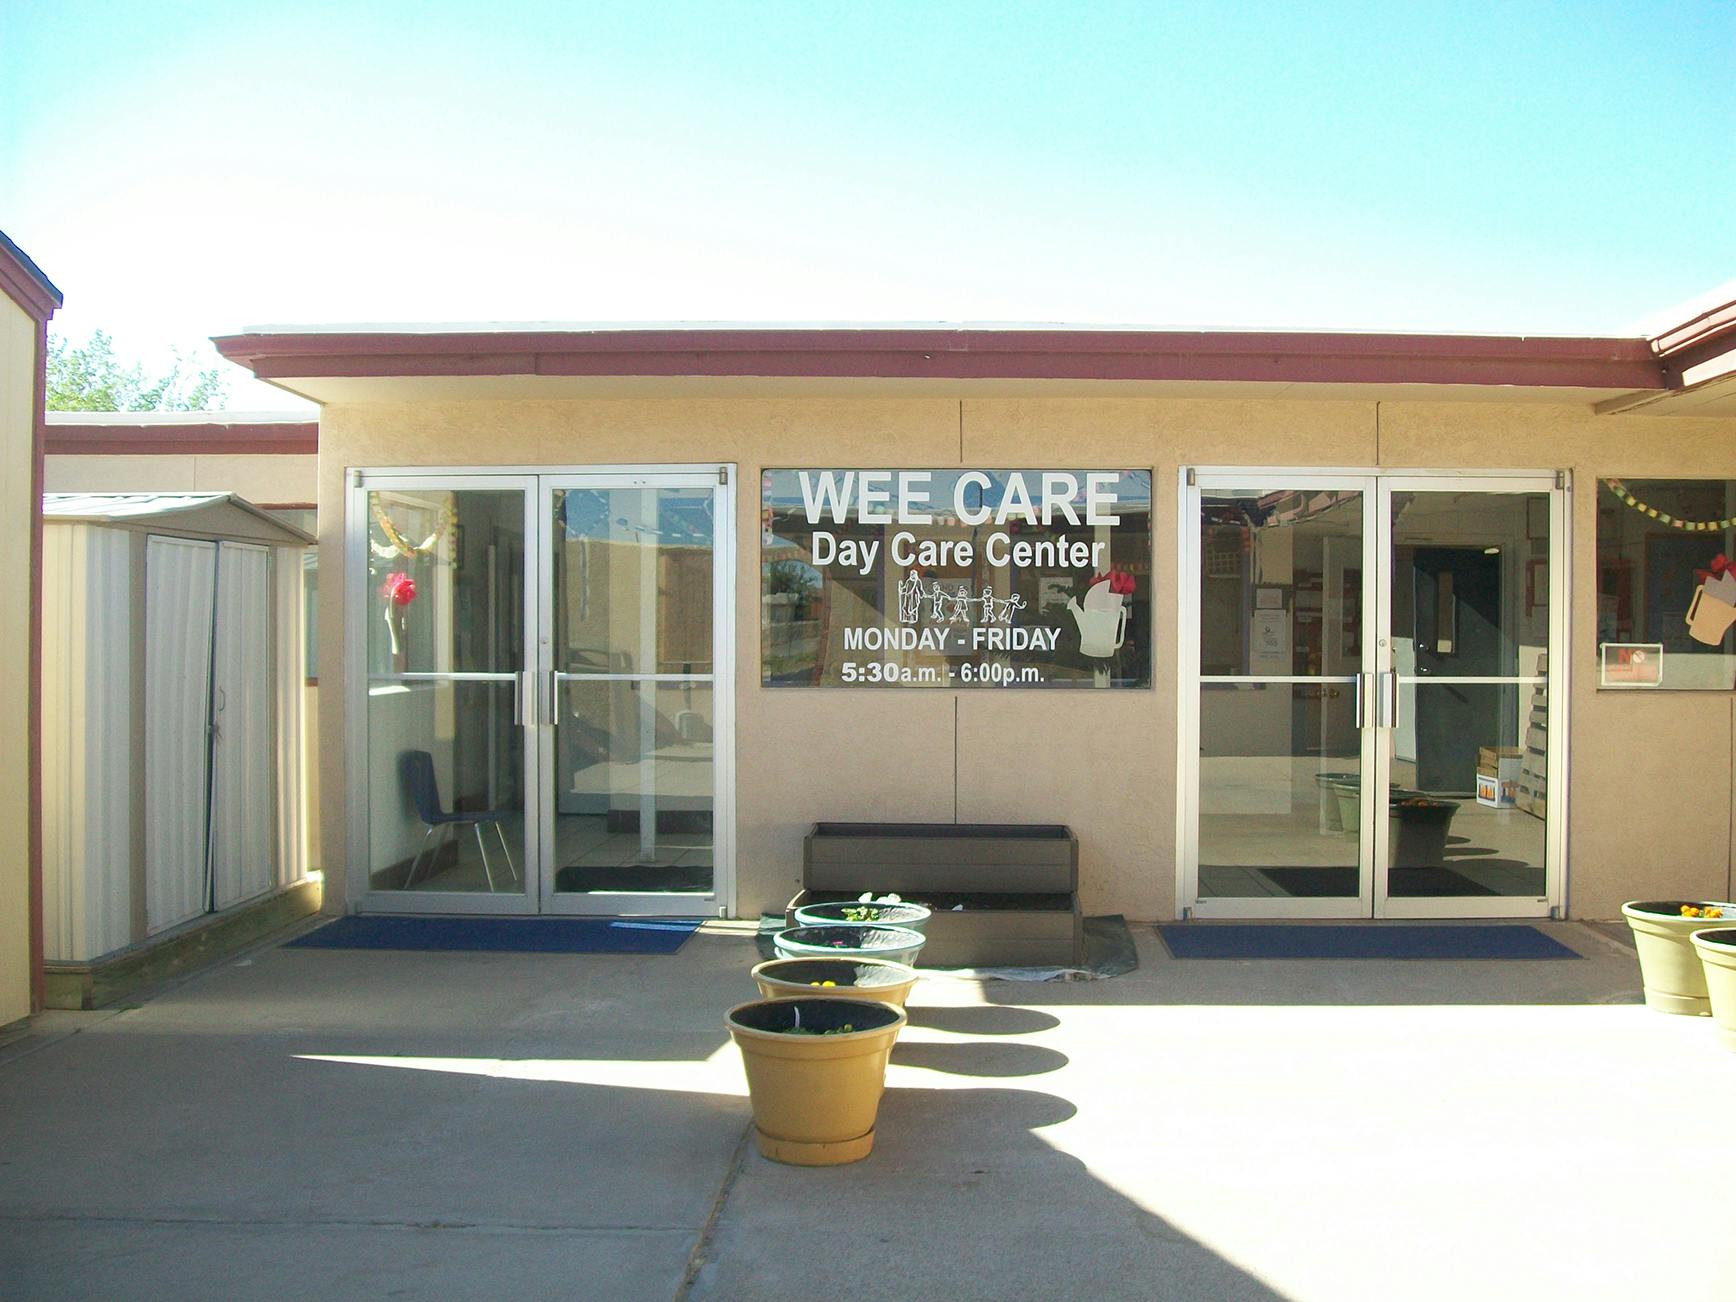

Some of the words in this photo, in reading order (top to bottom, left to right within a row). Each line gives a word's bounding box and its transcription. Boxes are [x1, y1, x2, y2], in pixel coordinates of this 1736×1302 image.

[799, 471, 933, 524] WEE
[954, 471, 1121, 526] CARE
[812, 531, 879, 575] Day
[892, 531, 974, 567] Care
[986, 532, 1106, 567] Center
[844, 628, 950, 650] MONDAY
[972, 628, 1062, 650] FRIDAY
[960, 662, 1045, 686] 6:00p.m.
